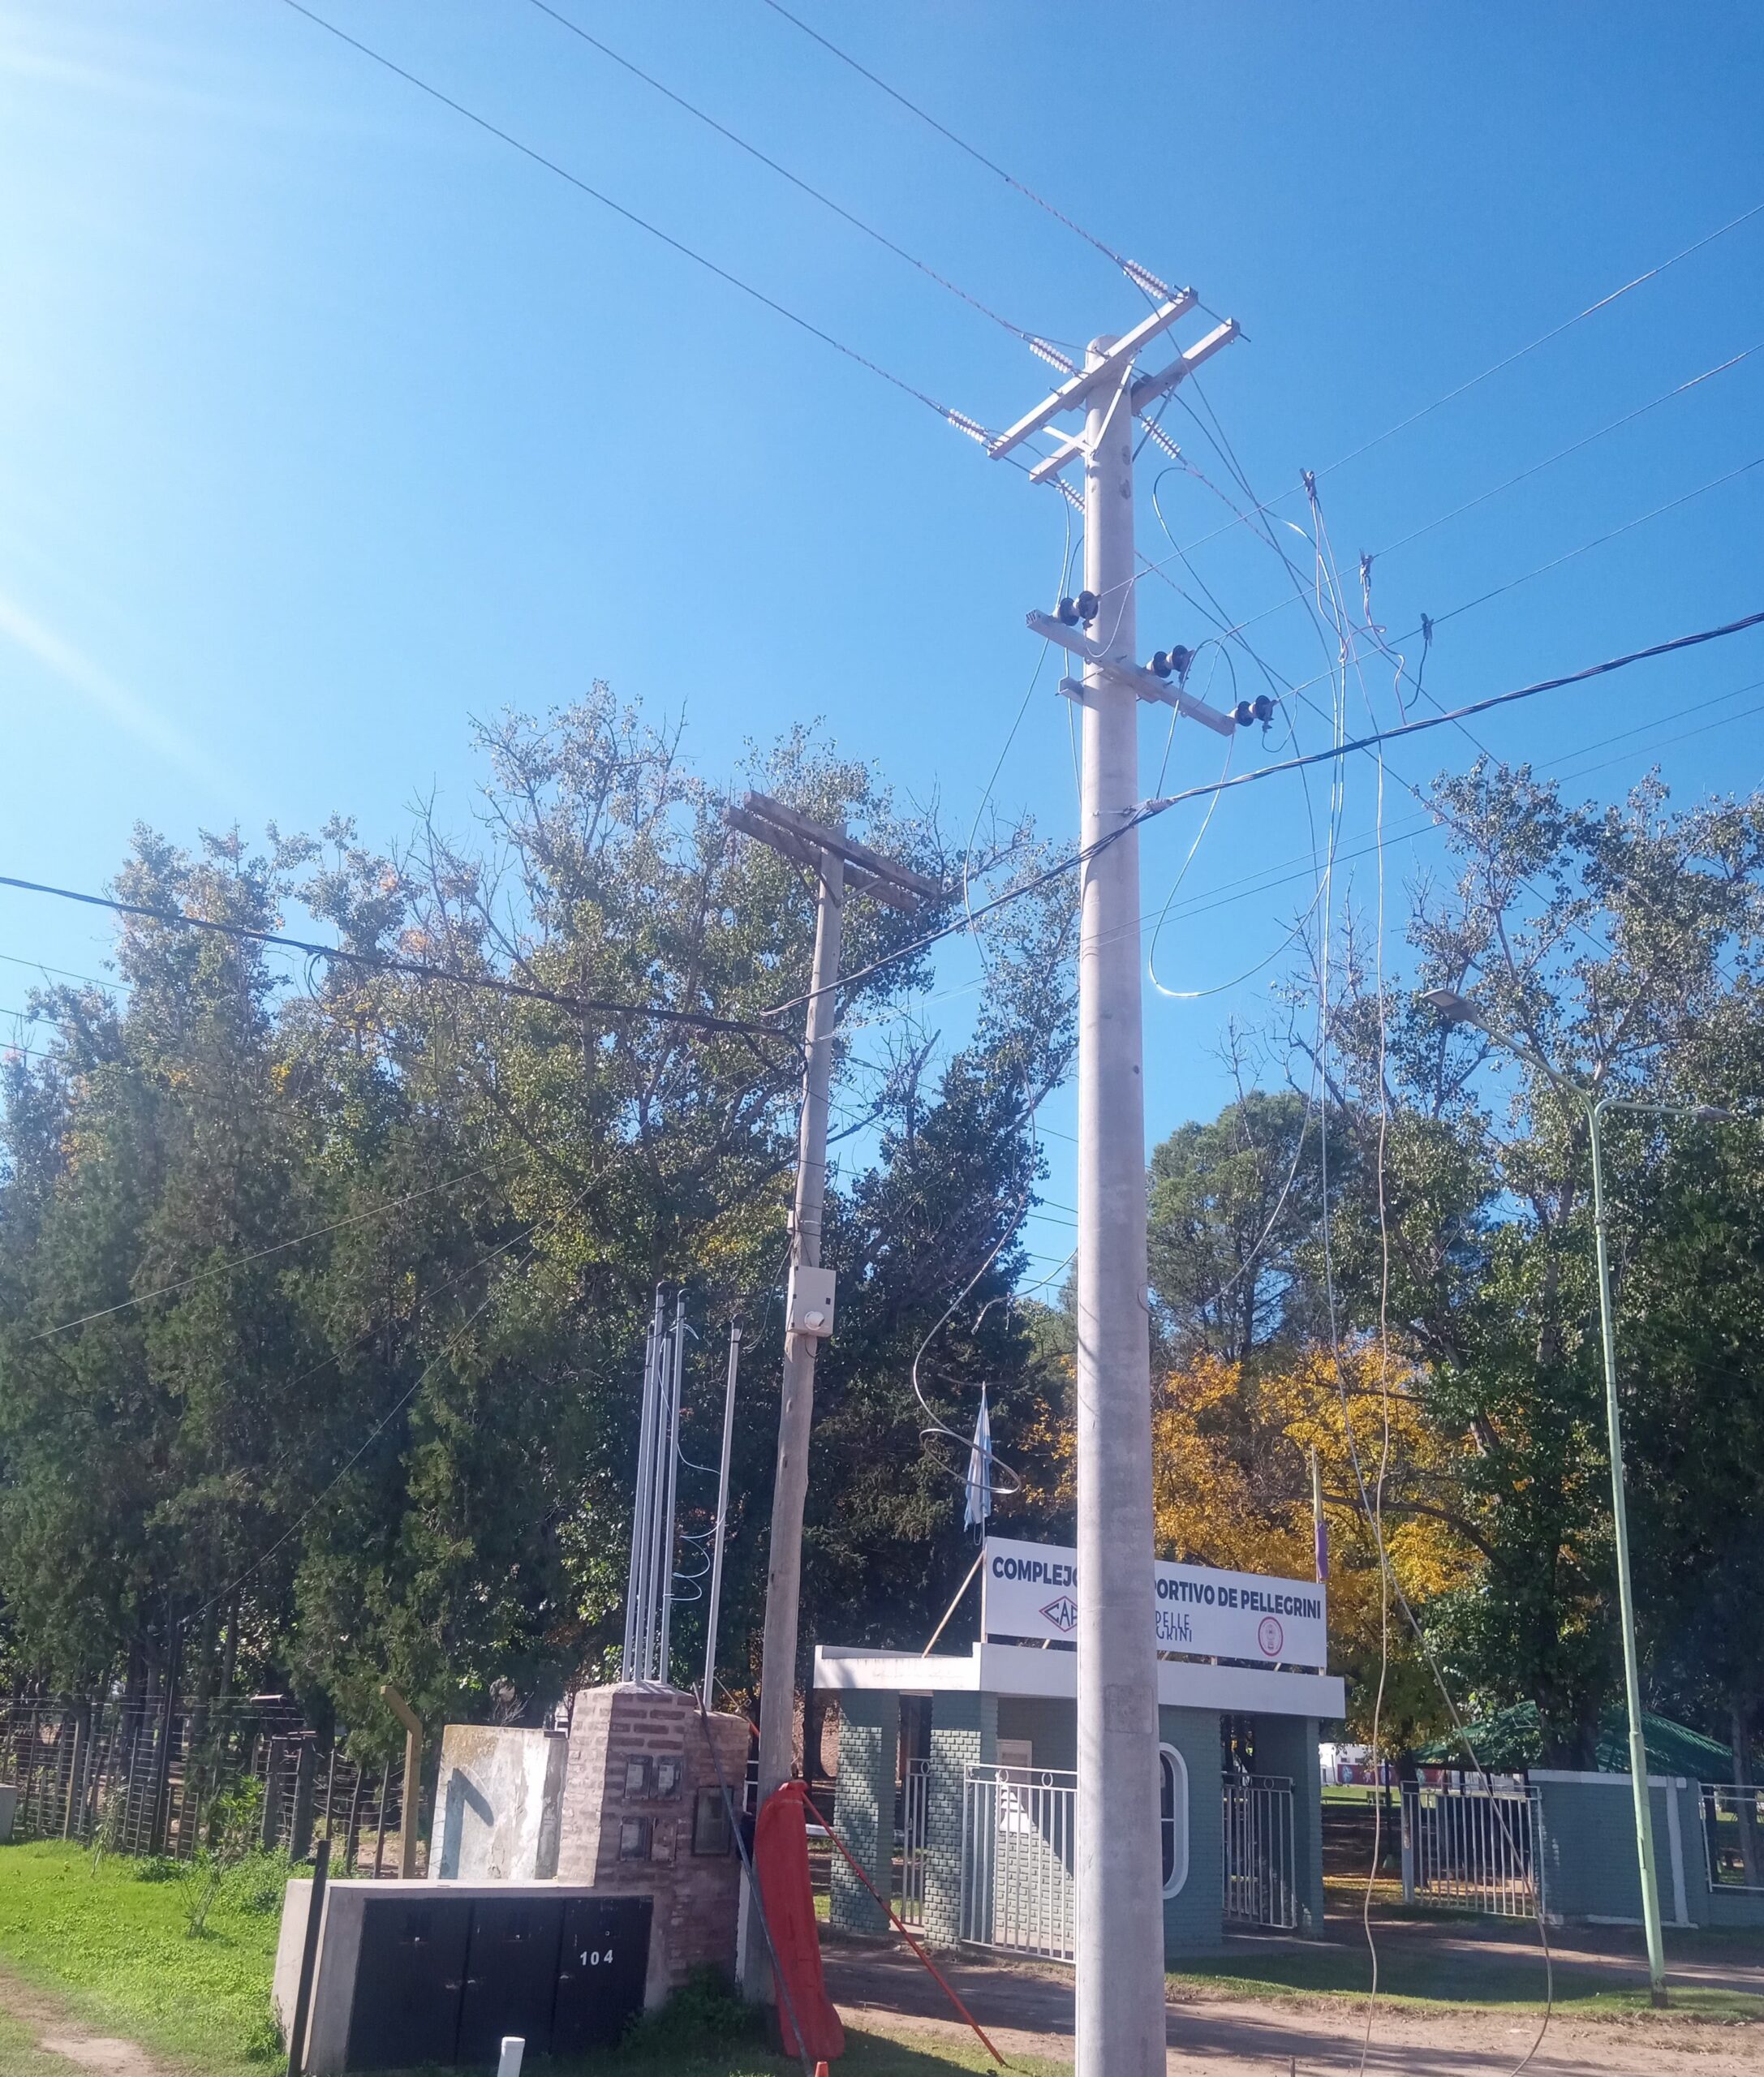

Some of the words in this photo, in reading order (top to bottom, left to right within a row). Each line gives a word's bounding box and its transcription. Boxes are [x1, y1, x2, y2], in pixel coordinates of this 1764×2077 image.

[1155, 1578, 1215, 1606] ORTIVO
[1218, 1586, 1238, 1609] DE
[1241, 1589, 1321, 1619] PELLEGRINI
[1155, 1610, 1190, 1631] PELLE
[580, 1949, 613, 1966] 104
